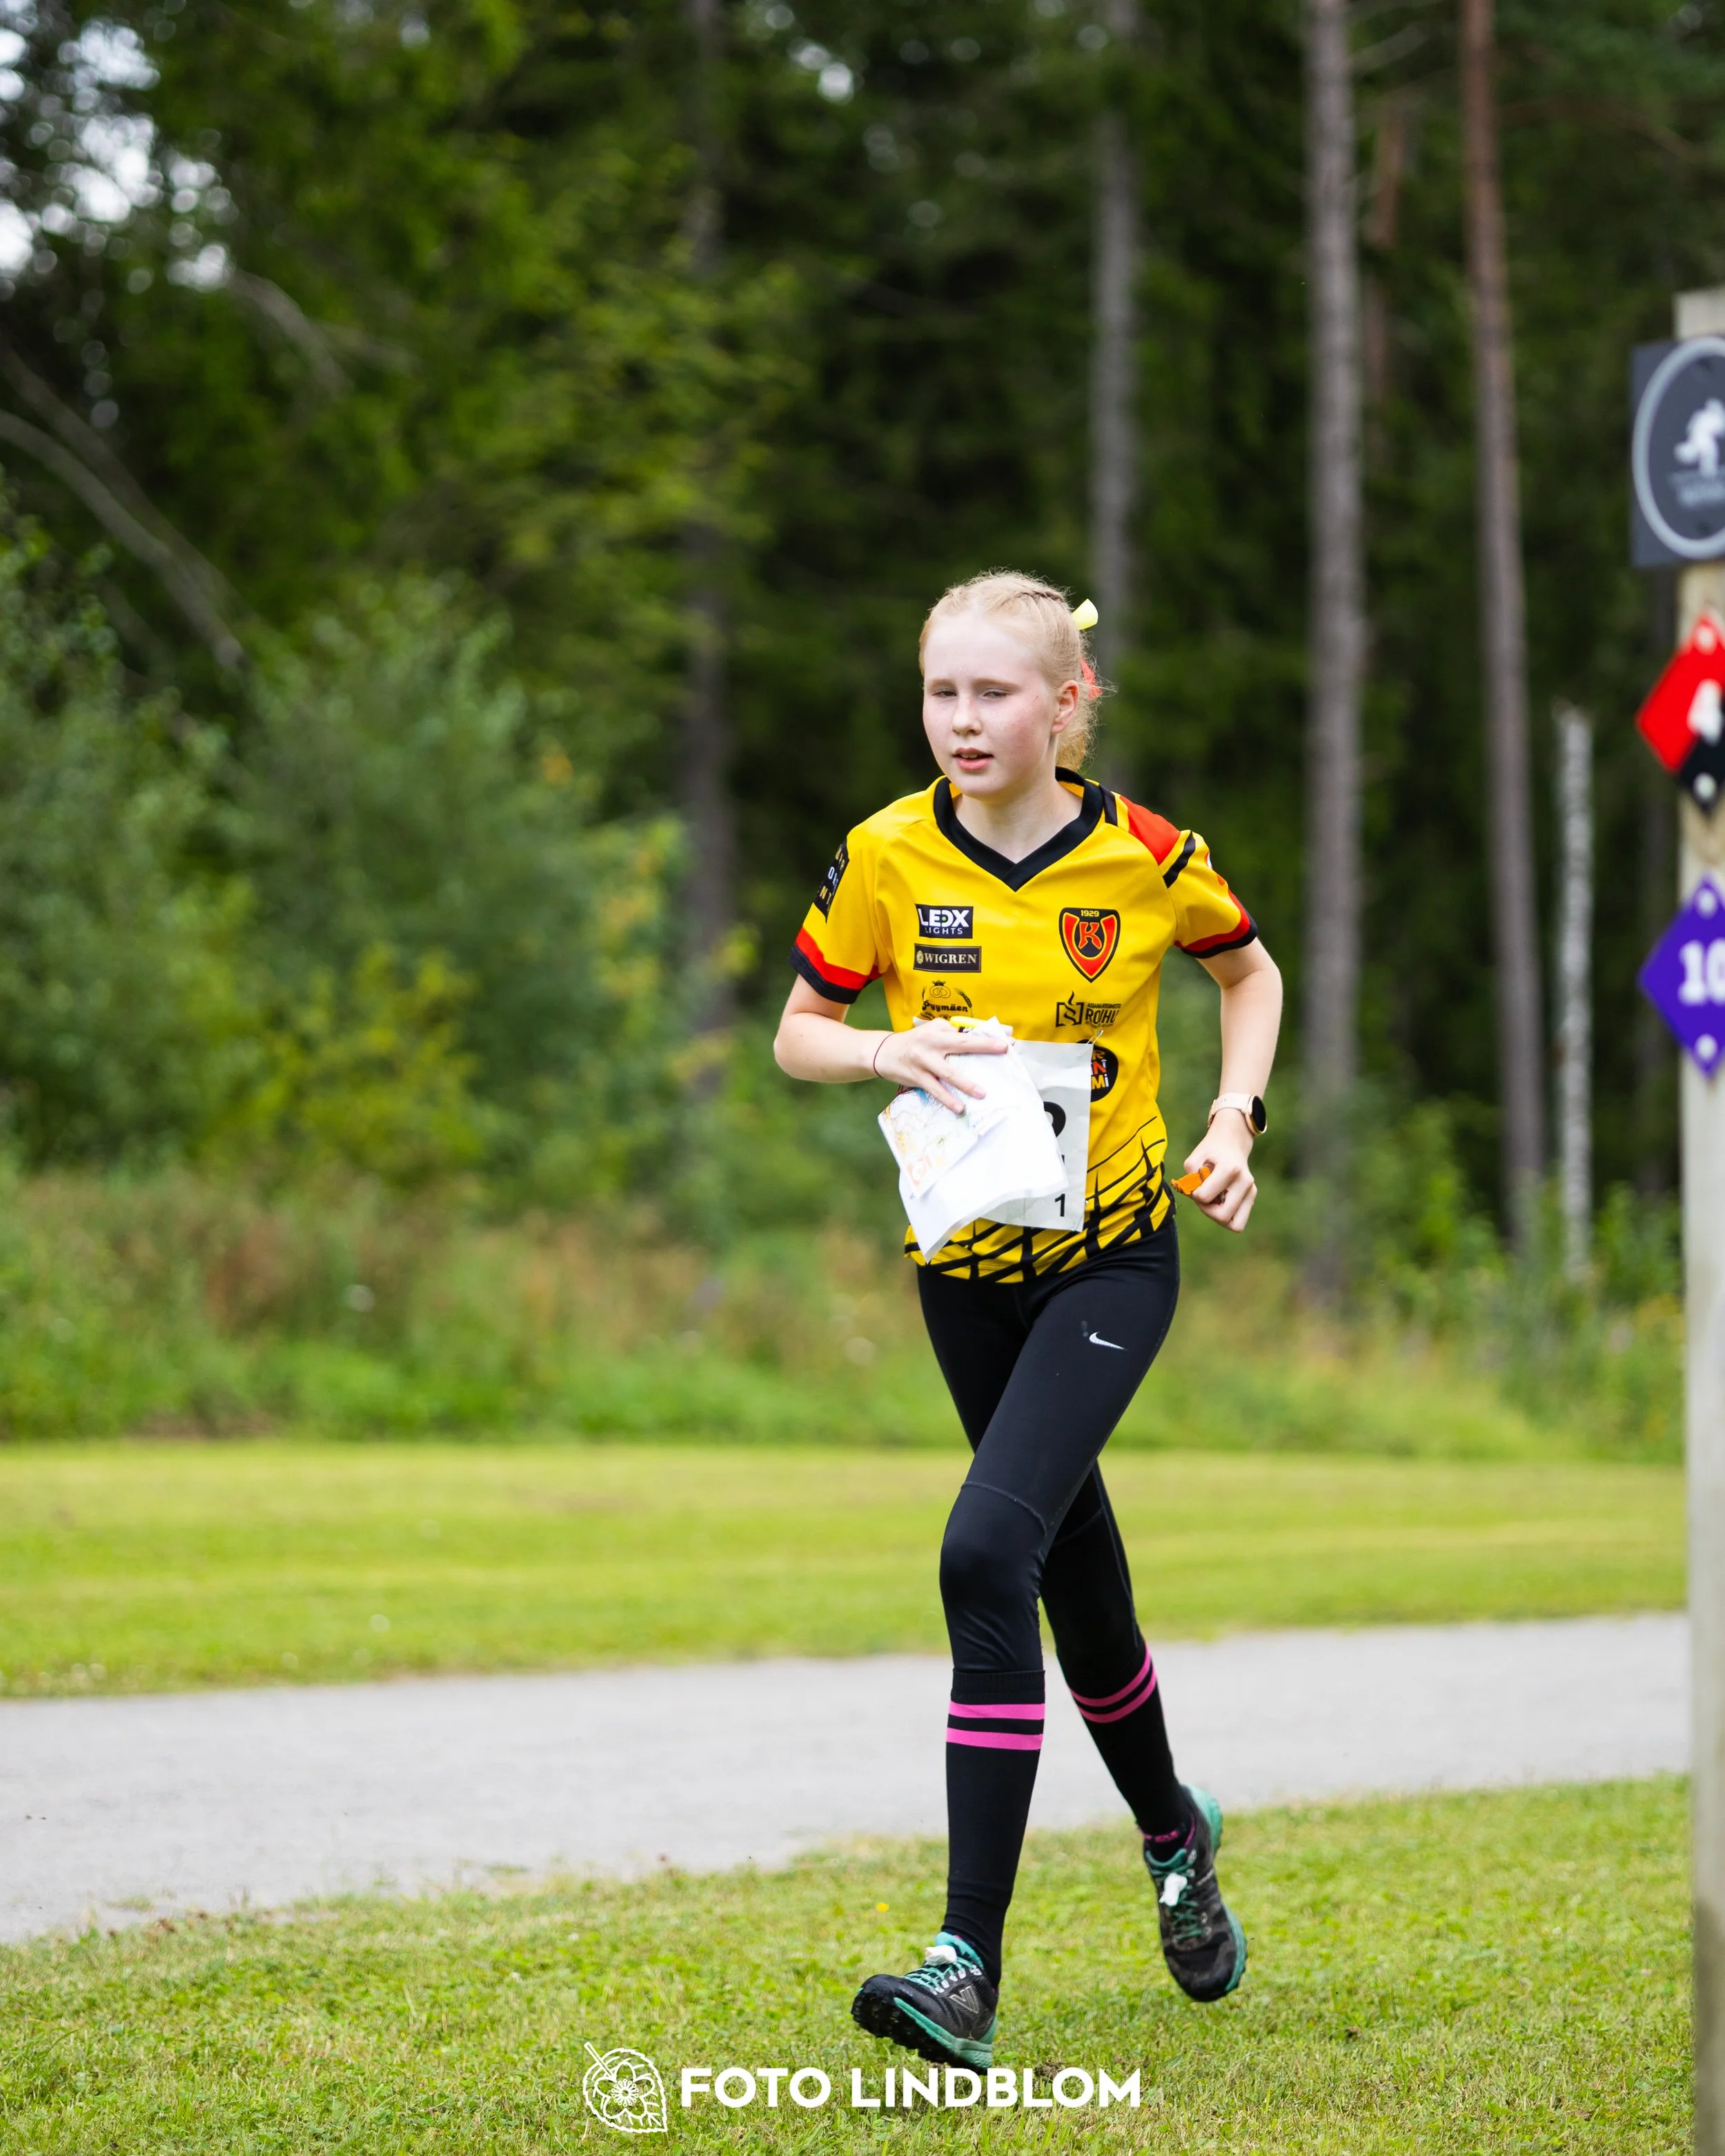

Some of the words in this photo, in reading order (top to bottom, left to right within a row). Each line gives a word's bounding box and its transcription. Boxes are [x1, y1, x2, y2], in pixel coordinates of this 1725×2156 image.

[1687, 678, 1722, 746] 4
[917, 908, 970, 928] LEDX
[1080, 909, 1100, 918] 1929
[925, 927, 964, 935] LIGHTS
[924, 952, 978, 964] WIGREN
[1085, 1007, 1120, 1024] ROIHU
[1054, 1193, 1066, 1217] 1
